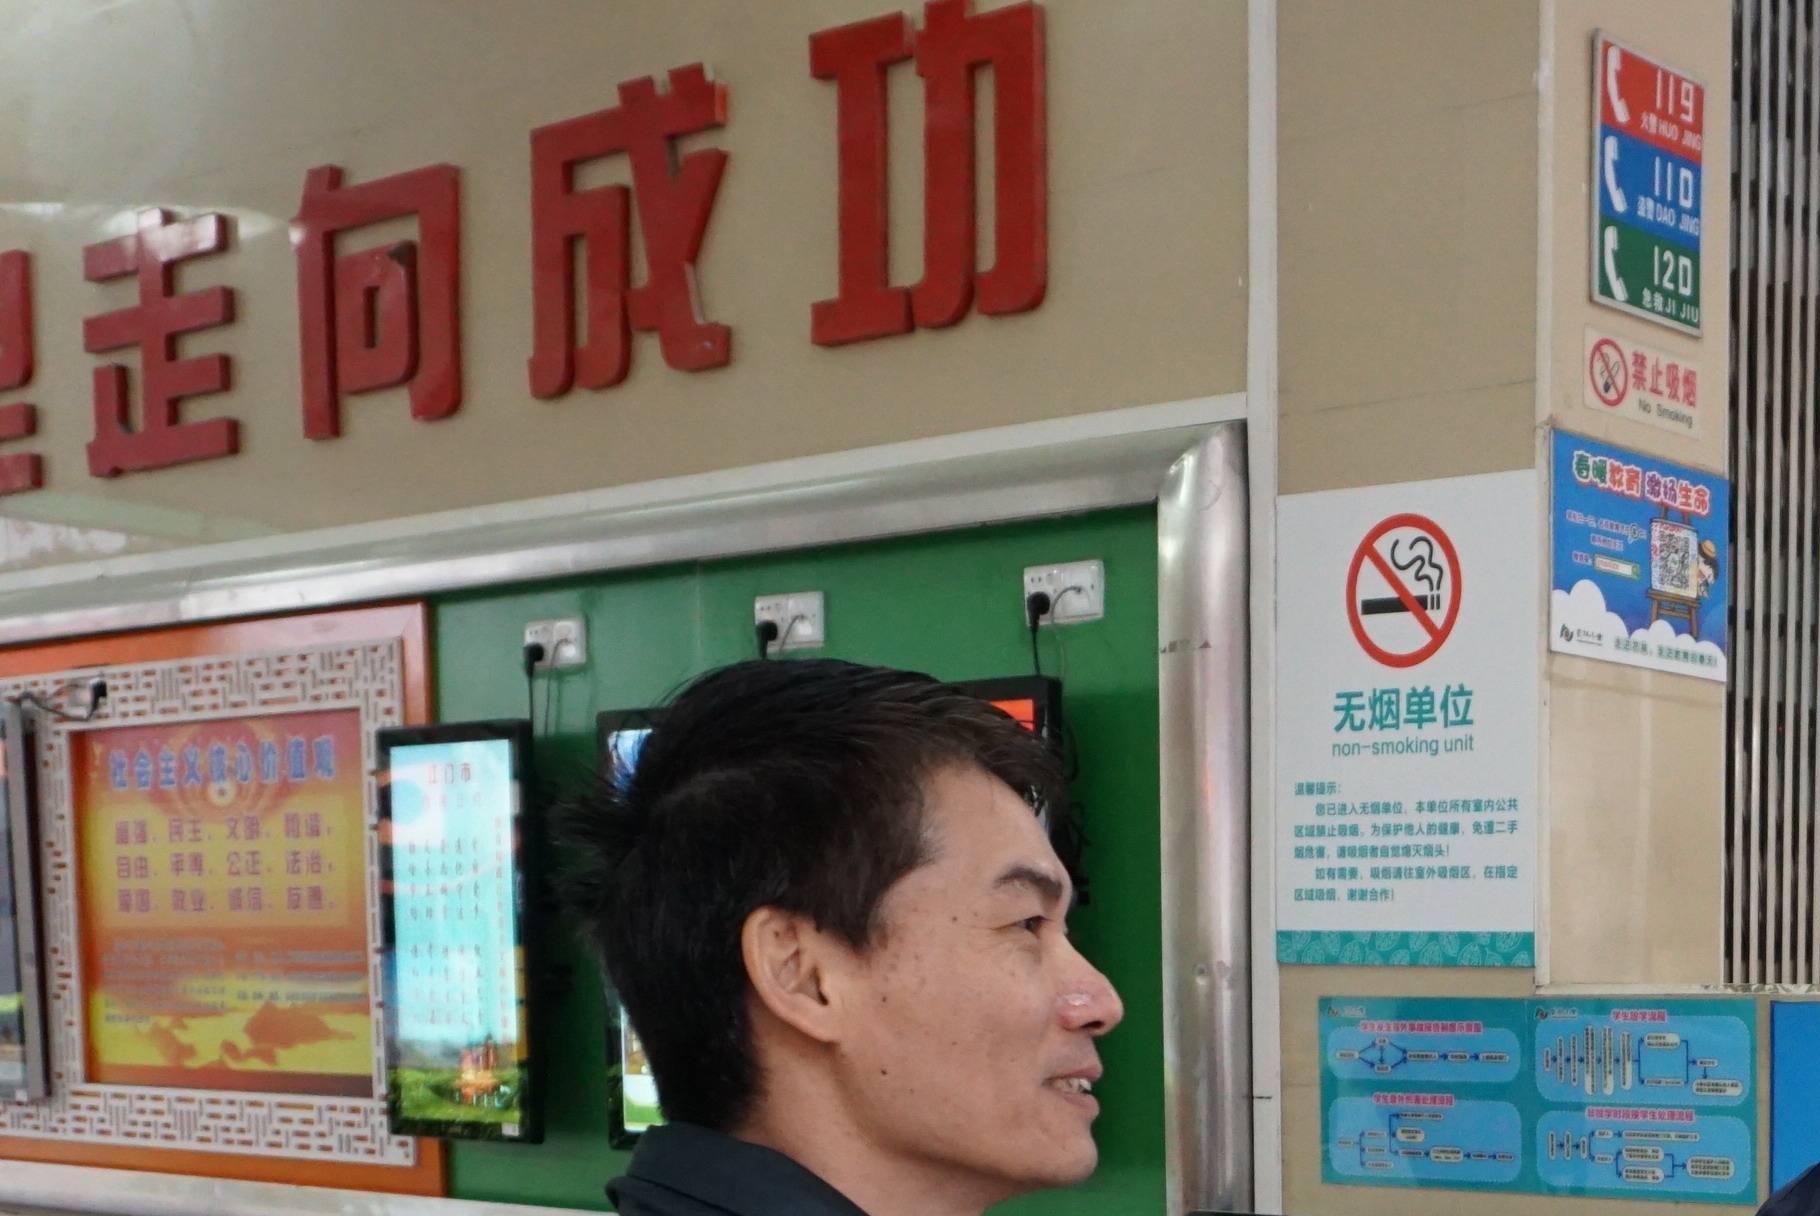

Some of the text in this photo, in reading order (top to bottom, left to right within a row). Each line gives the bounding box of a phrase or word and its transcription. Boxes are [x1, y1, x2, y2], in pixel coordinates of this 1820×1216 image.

[1656, 68, 1694, 122] 119
[1658, 119, 1679, 141] HUO
[1682, 129, 1701, 150] JING
[1654, 156, 1693, 208] 110
[1656, 206, 1675, 227] DAO
[1679, 214, 1700, 236] JING
[0, 0, 1049, 495] 走向成功
[1653, 245, 1692, 297] 120
[1665, 299, 1676, 316] JI
[1680, 302, 1699, 323] JIU
[1632, 350, 1697, 407] 禁止吸烟
[1638, 398, 1693, 429] No Smoking
[1333, 683, 1474, 735] 无烟单位
[110, 736, 335, 790] 社会主义核心价值观
[1331, 733, 1474, 759] non-smoking unit
